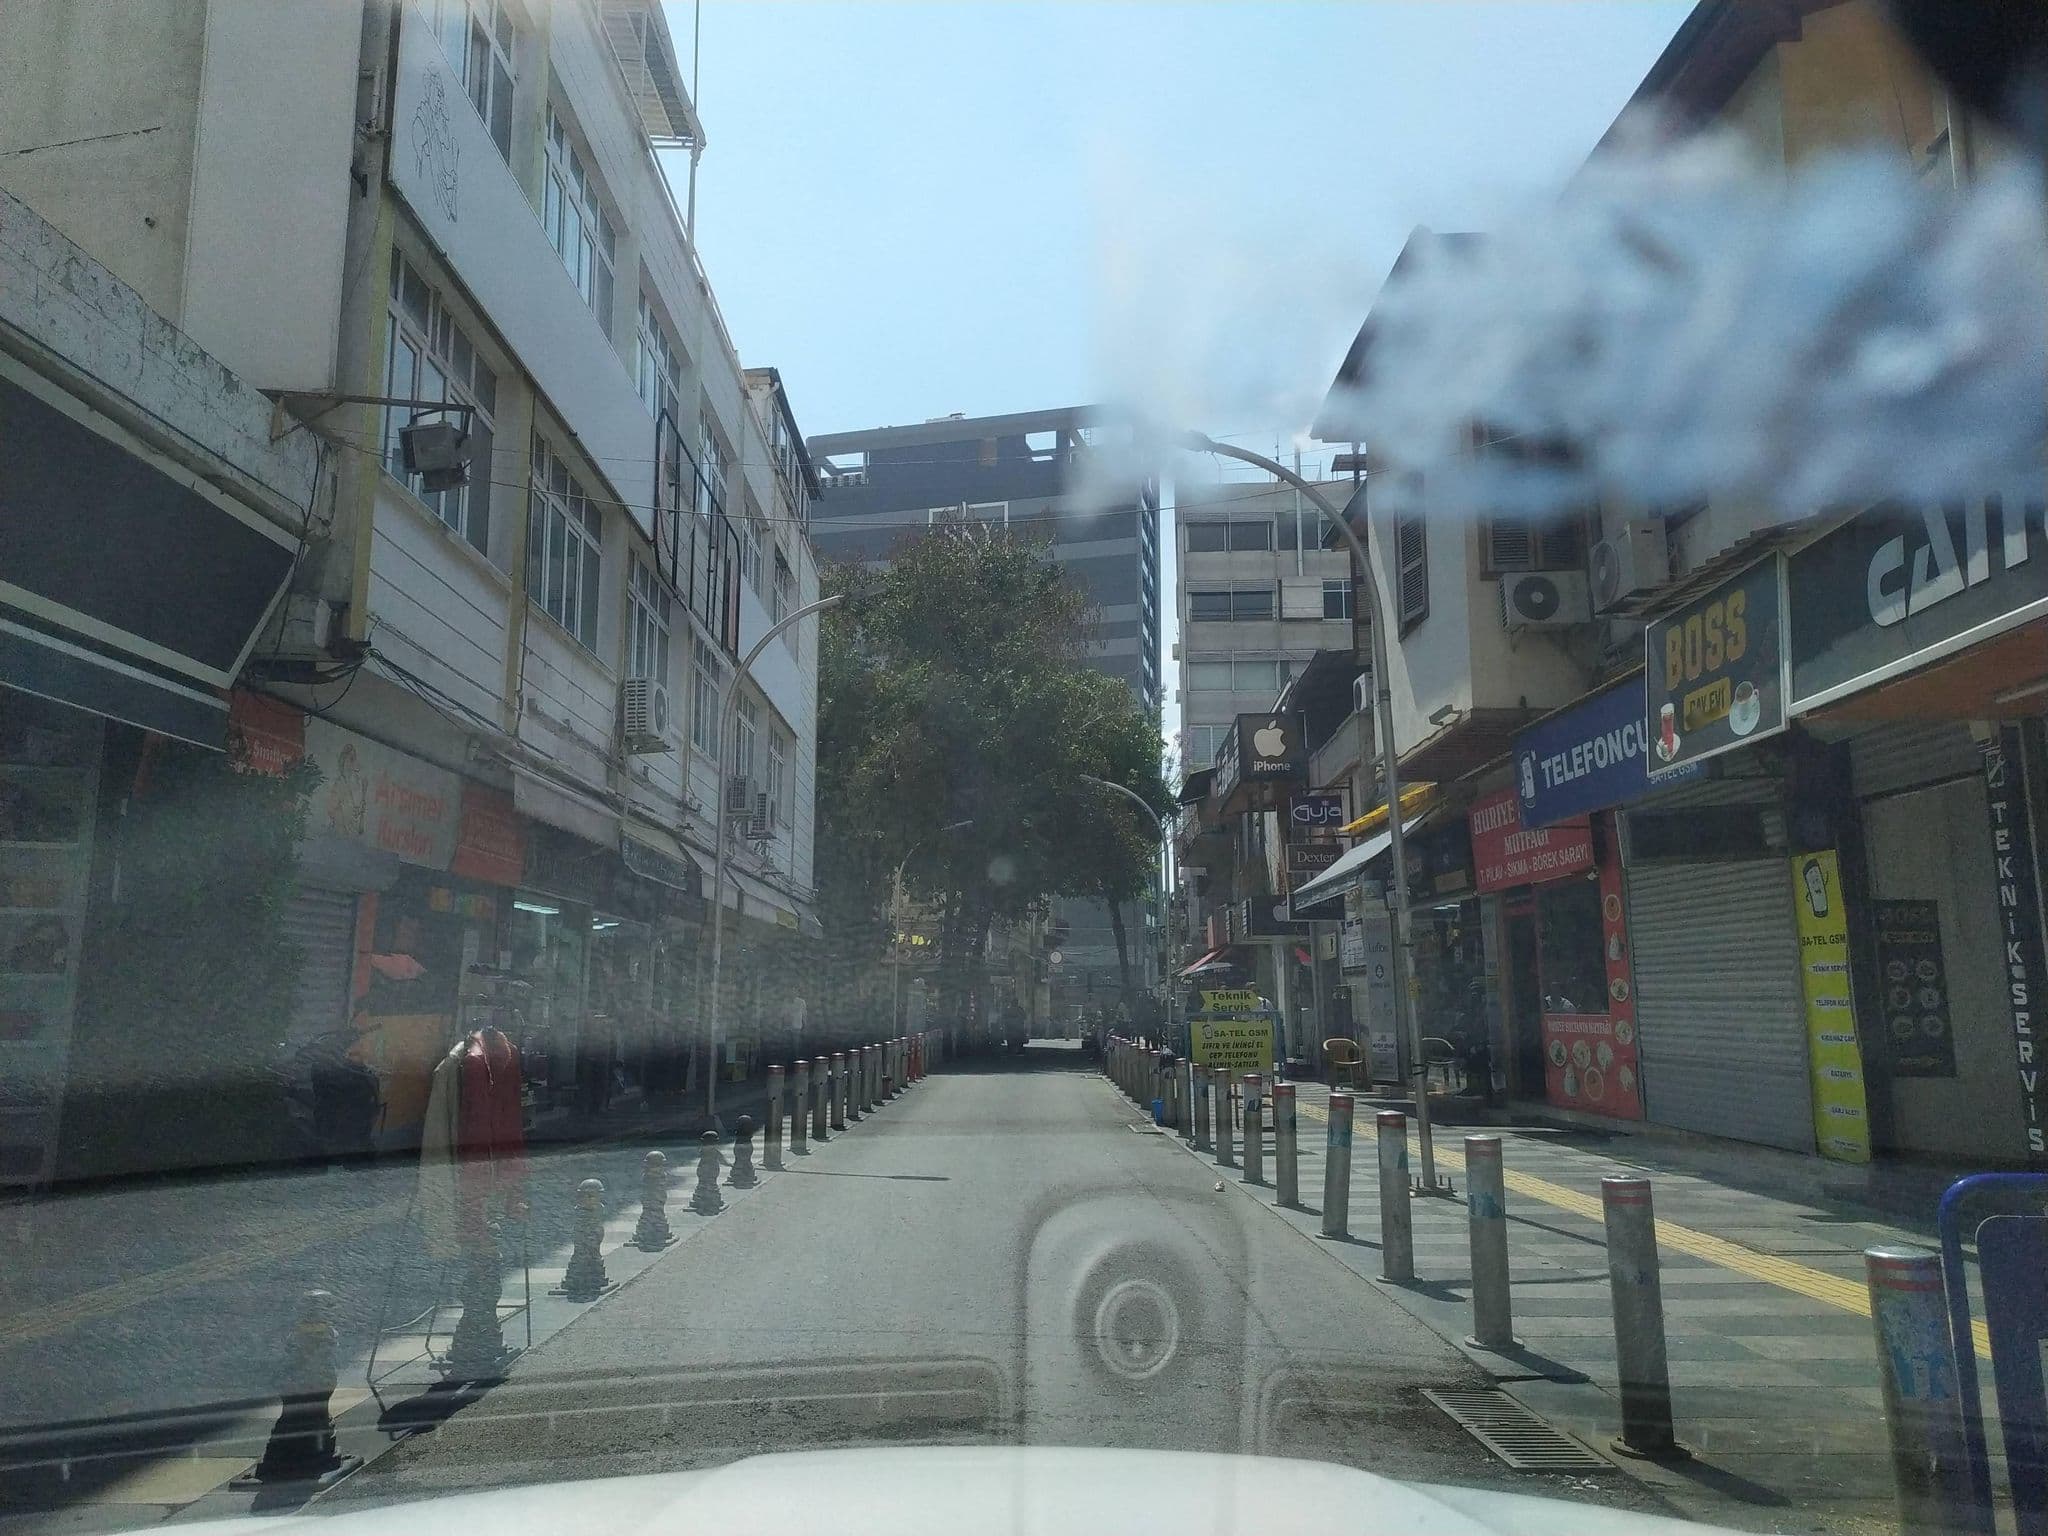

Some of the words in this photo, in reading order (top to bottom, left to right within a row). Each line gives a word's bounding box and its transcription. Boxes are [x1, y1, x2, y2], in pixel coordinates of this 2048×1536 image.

[1665, 588, 1747, 692] BOSS
[1253, 760, 1291, 772] iPhone
[1296, 850, 1335, 863] Dexter
[1210, 991, 1251, 1001] Teknik
[1212, 1003, 1251, 1012] Servis
[1213, 1029, 1246, 1038] SA-TEL
[1248, 1029, 1268, 1037] GSM
[1224, 1051, 1258, 1059] TELEFONU
